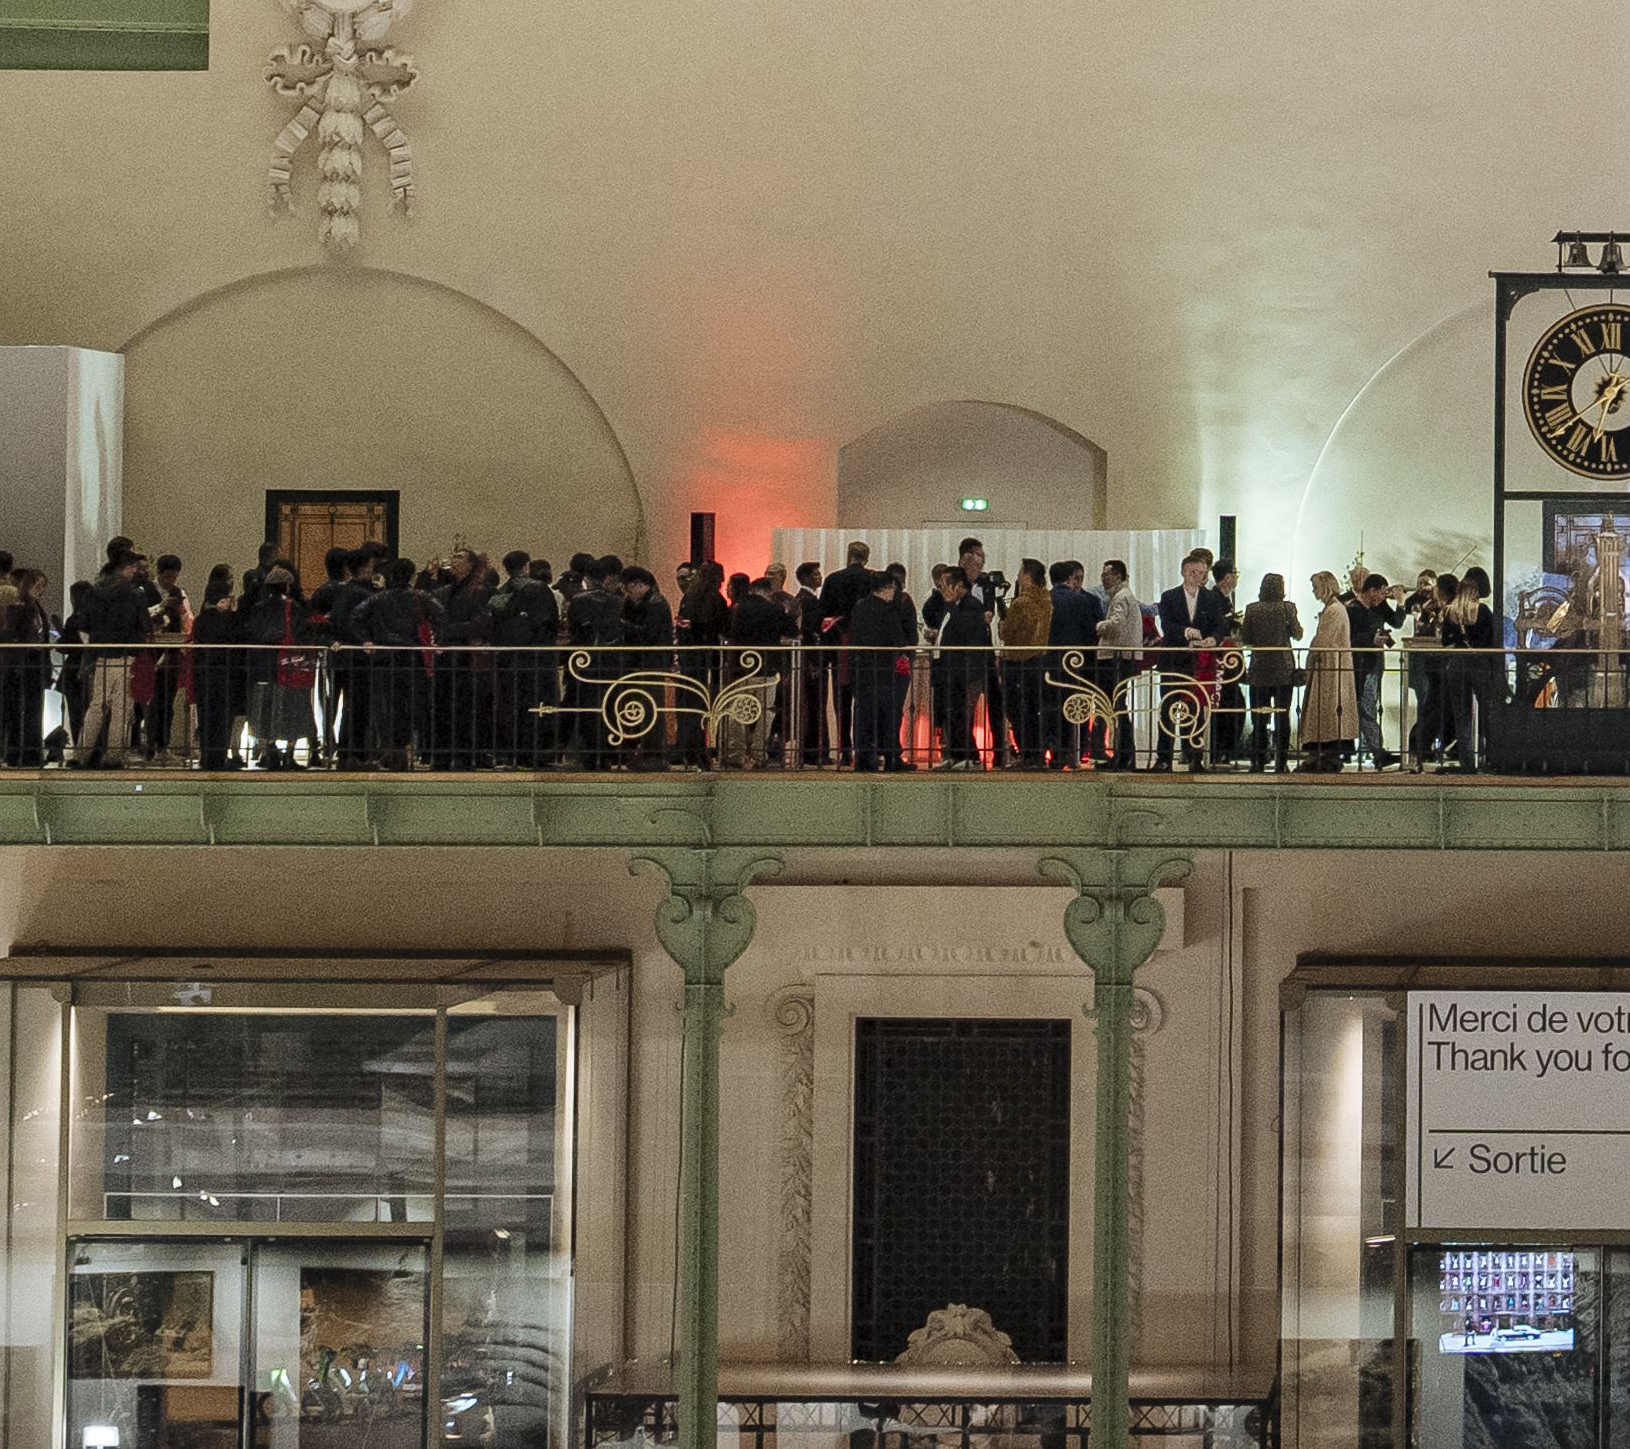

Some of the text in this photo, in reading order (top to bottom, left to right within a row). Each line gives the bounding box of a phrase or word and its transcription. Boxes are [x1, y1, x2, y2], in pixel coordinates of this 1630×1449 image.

[1428, 1003, 1518, 1034] Merci
[1526, 1003, 1568, 1034] de
[1427, 1041, 1528, 1072] Thank
[1535, 1047, 1593, 1078] you
[1469, 1143, 1568, 1175] Sortie
